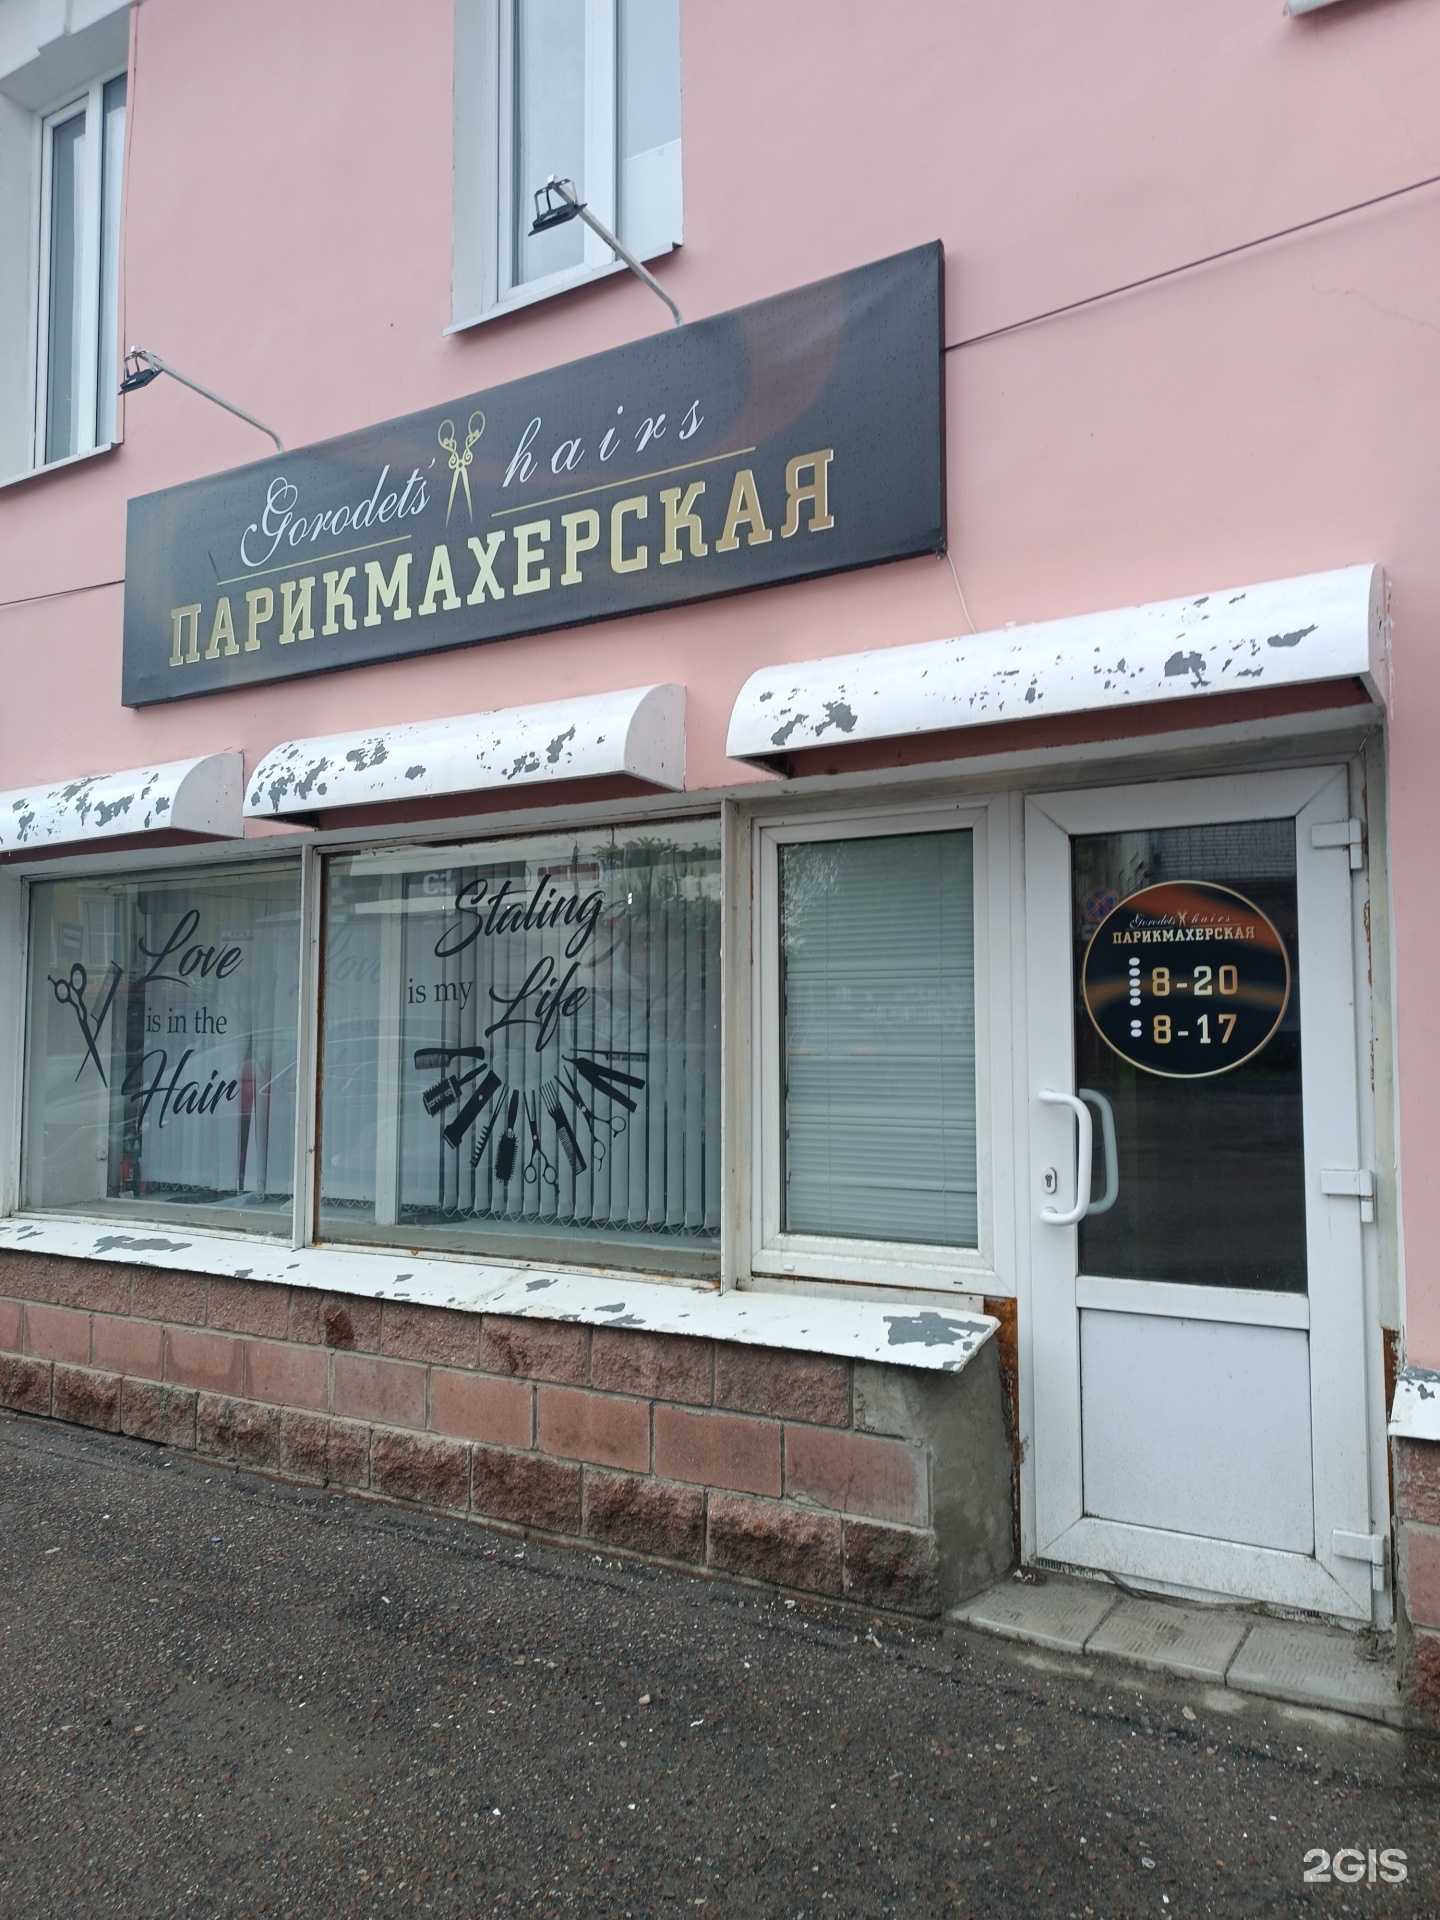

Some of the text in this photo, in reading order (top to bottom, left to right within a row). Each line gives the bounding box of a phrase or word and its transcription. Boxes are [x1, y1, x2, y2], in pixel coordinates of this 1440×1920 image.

[502, 400, 704, 488] hairs
[169, 448, 836, 667] ПАРИКМАХЕРСКАЯ
[139, 909, 242, 987] Love
[1112, 926, 1255, 944] ПАРИКМАХЕРСКАЯ
[408, 956, 592, 1052] is my Life
[1152, 964, 1238, 996] 8-20
[146, 1007, 228, 1034] is in the
[1153, 1013, 1237, 1044] 8-17
[121, 1049, 240, 1128] Hair
